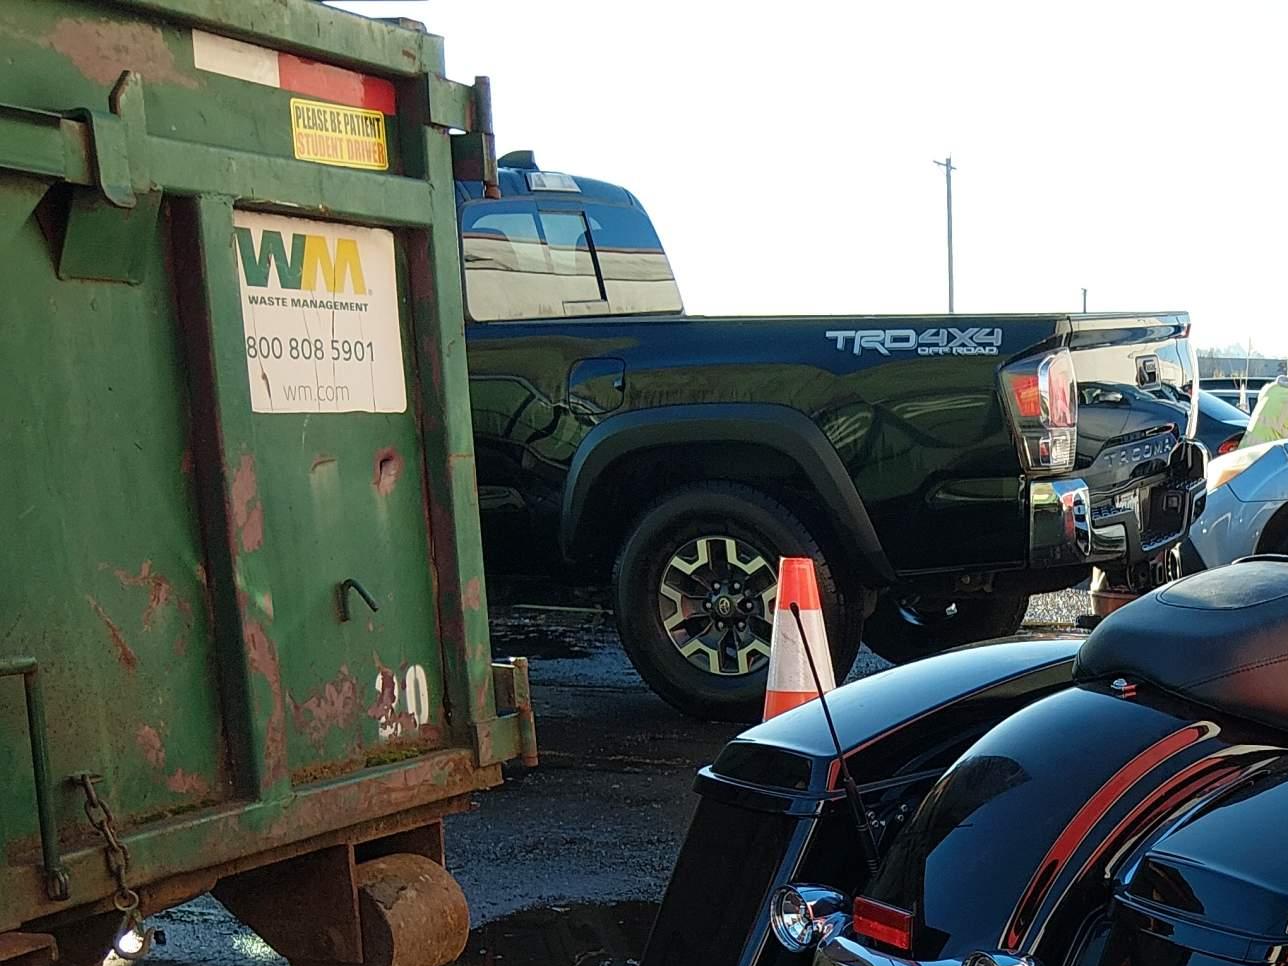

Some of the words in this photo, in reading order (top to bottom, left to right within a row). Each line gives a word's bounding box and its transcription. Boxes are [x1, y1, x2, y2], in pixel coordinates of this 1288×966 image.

[294, 105, 330, 132] PLEASE
[329, 111, 343, 134] BE
[343, 112, 381, 139] PATIENT
[296, 131, 344, 159] STUDENT
[347, 139, 385, 164] DRIVER
[233, 226, 367, 295] WM
[248, 295, 288, 307] WASTE
[291, 298, 369, 312] MANAGEMENT
[246, 336, 283, 359] 800
[289, 337, 325, 361] 808
[331, 339, 375, 362] 5901
[283, 384, 350, 402] wm.com
[1103, 438, 1171, 468] TACOMA
